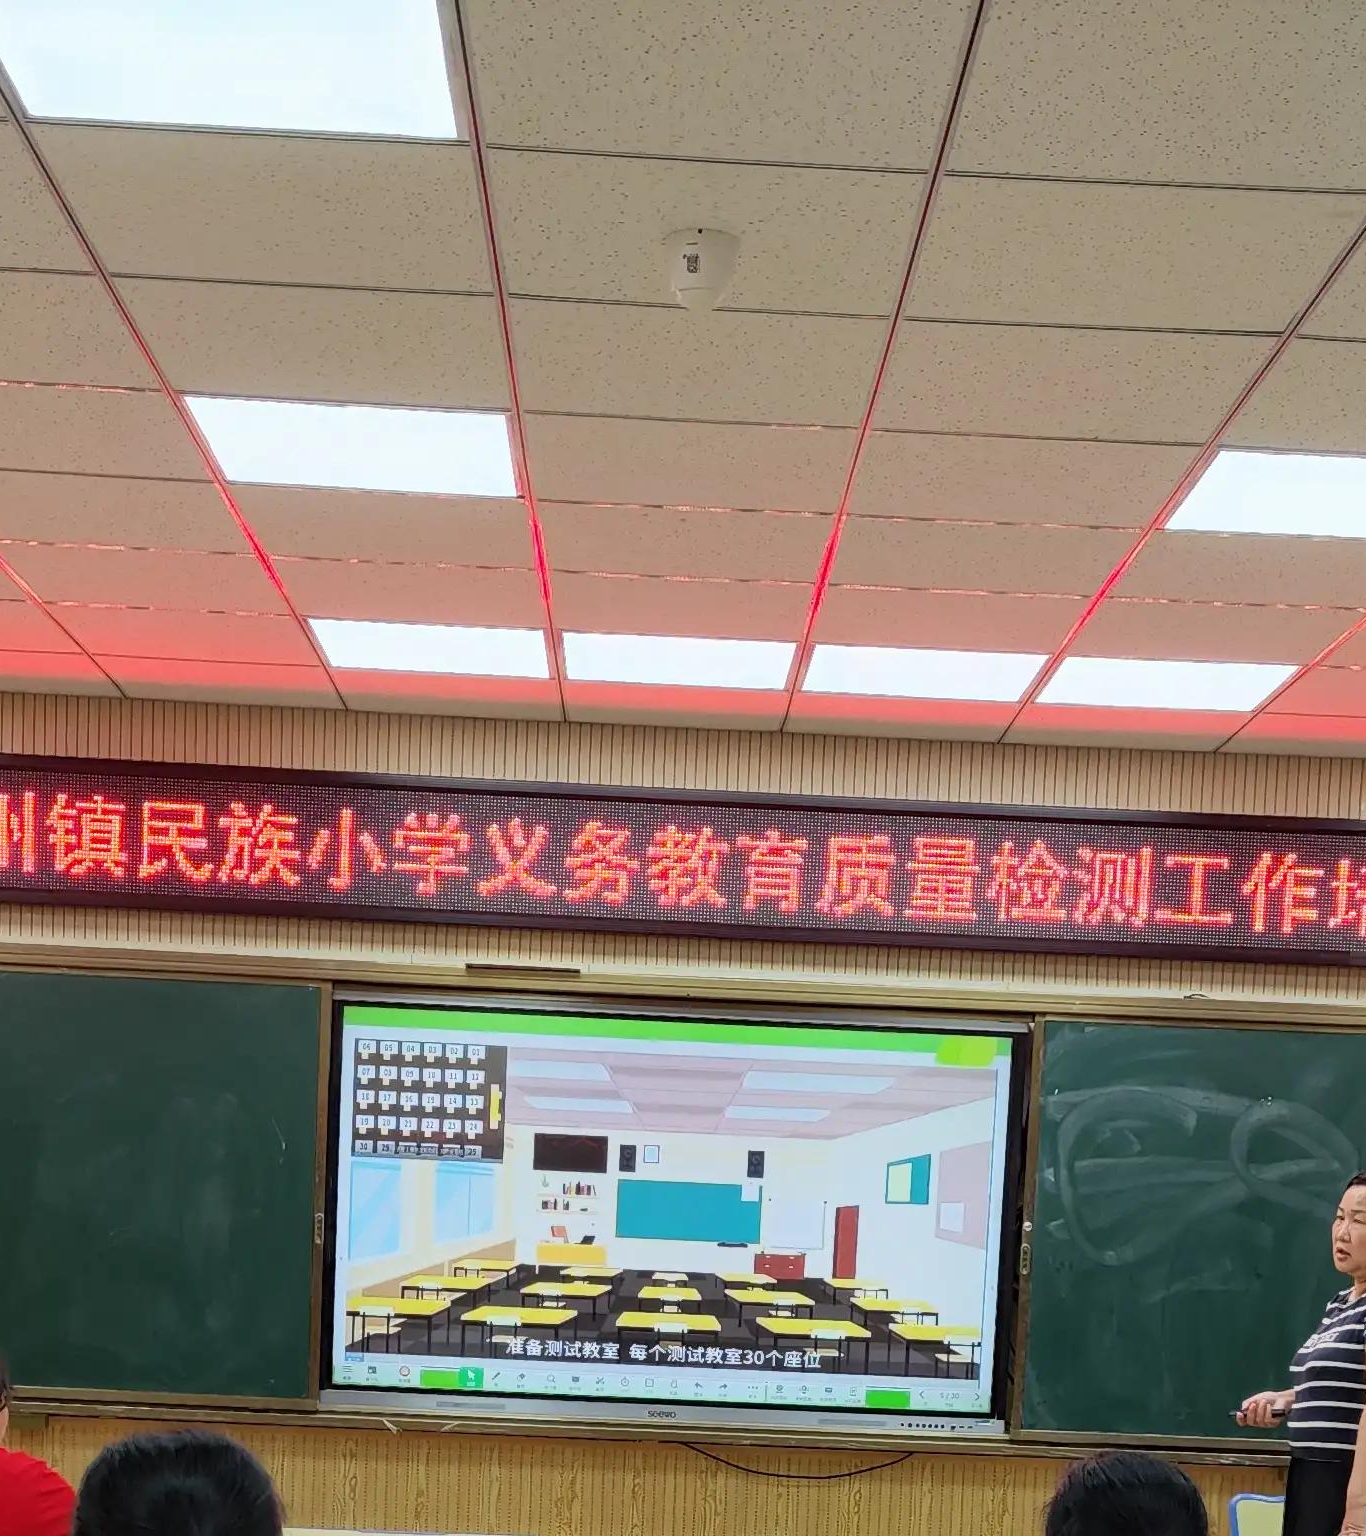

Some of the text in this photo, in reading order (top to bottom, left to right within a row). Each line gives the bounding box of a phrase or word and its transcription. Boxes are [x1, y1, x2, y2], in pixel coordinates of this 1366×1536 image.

[505, 1339, 822, 1369] 准备测试教室 每个测试教室30个座位
